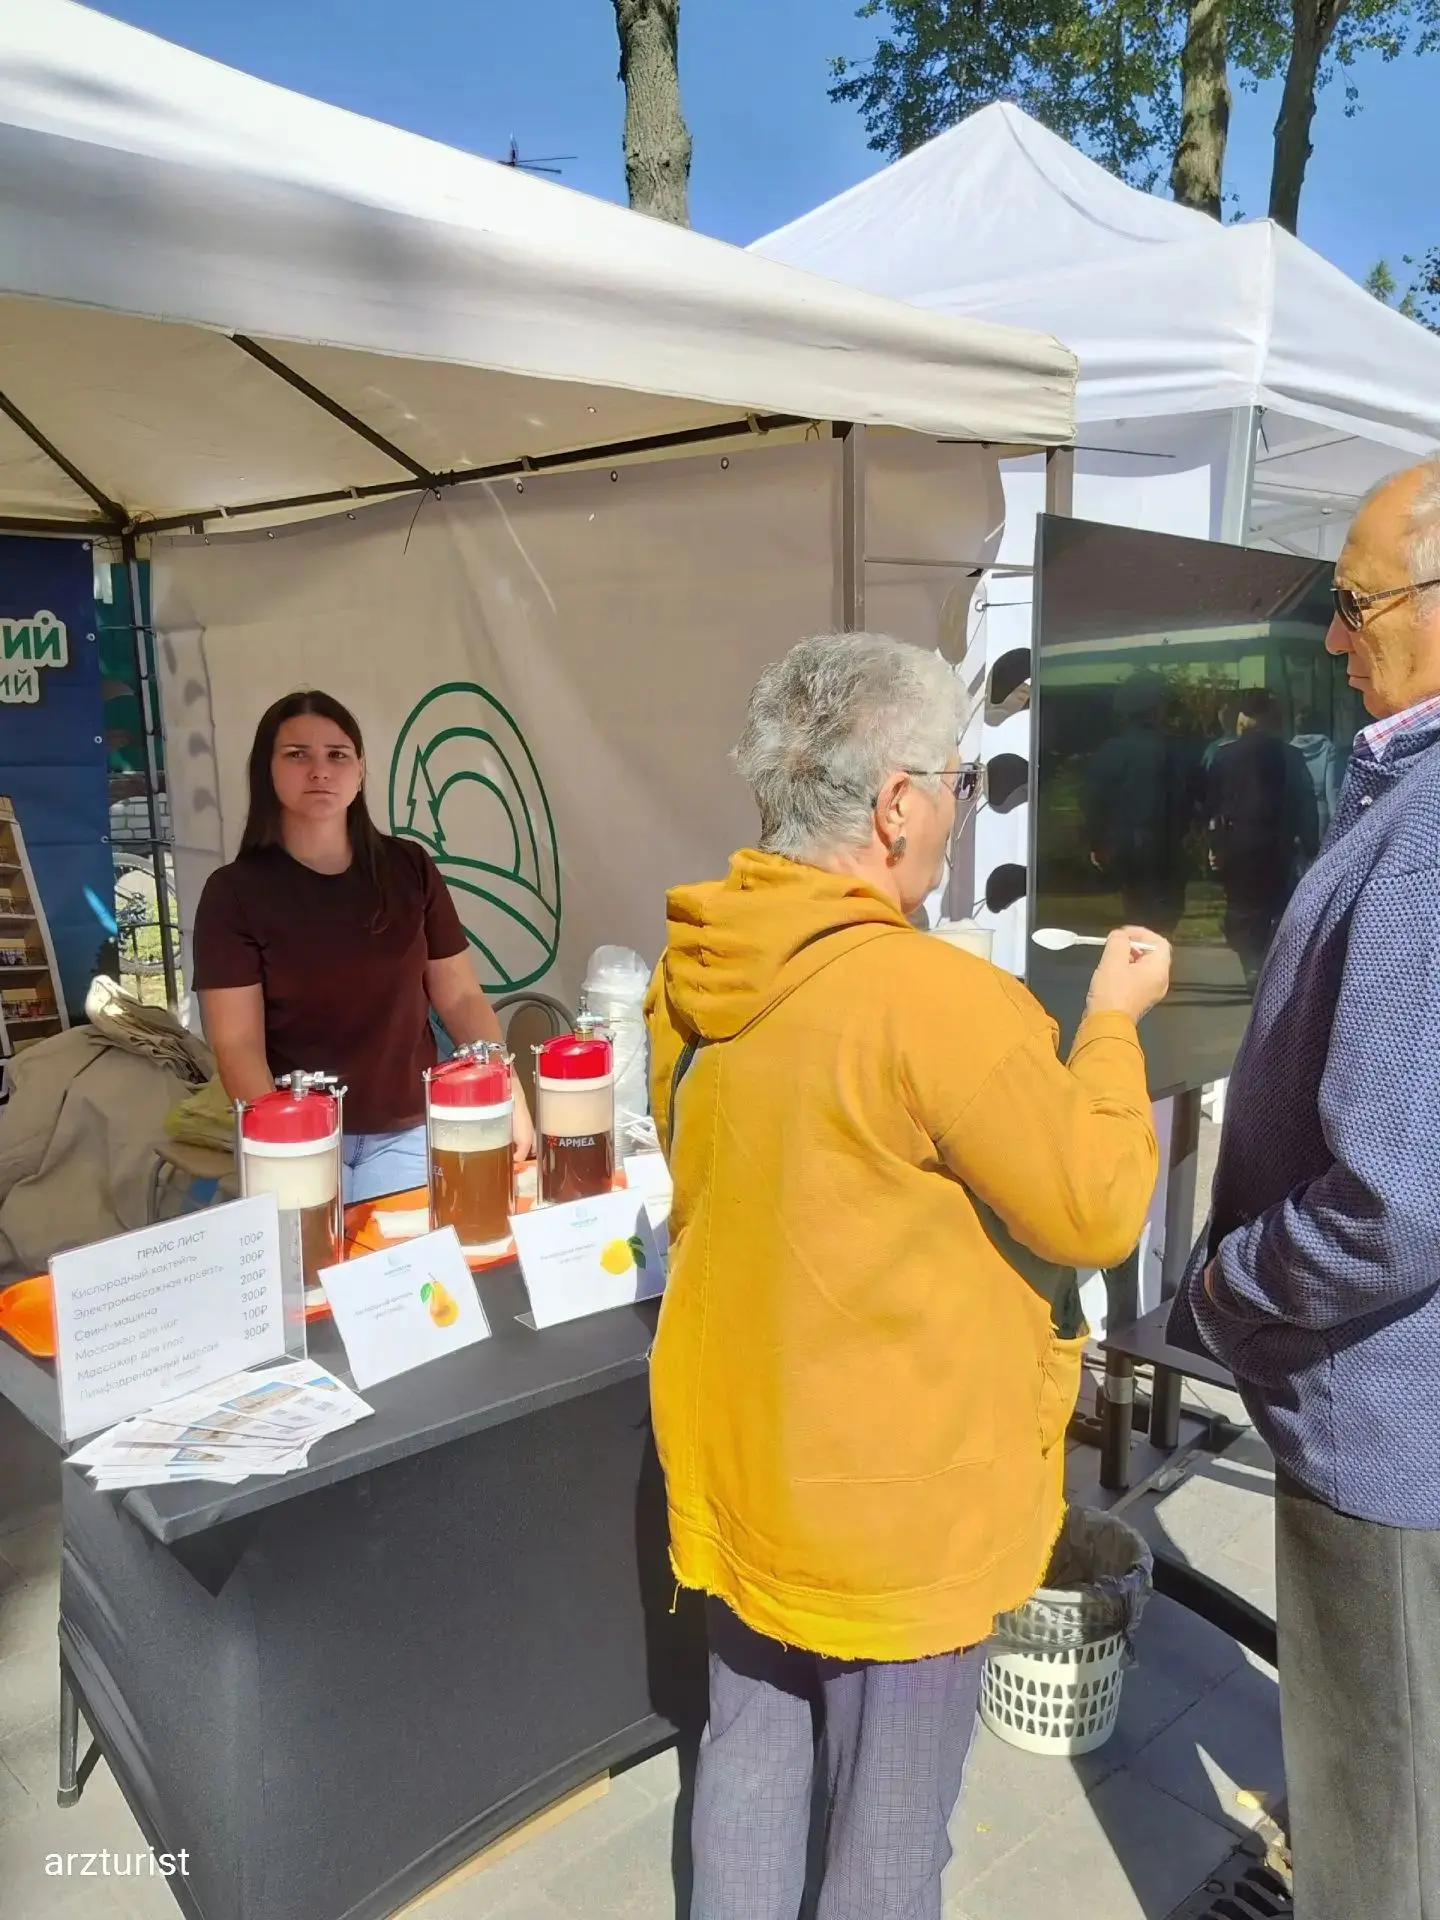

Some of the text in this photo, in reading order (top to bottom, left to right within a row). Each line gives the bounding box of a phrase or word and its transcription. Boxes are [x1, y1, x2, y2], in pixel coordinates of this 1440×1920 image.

[559, 1136, 596, 1148] АРМЕД
[137, 1230, 206, 1261] ПРАЙС ЛИСТ
[71, 1268, 148, 1300] Кислородный
[73, 1278, 181, 1320] Электромассажная
[184, 1264, 224, 1286] кровать
